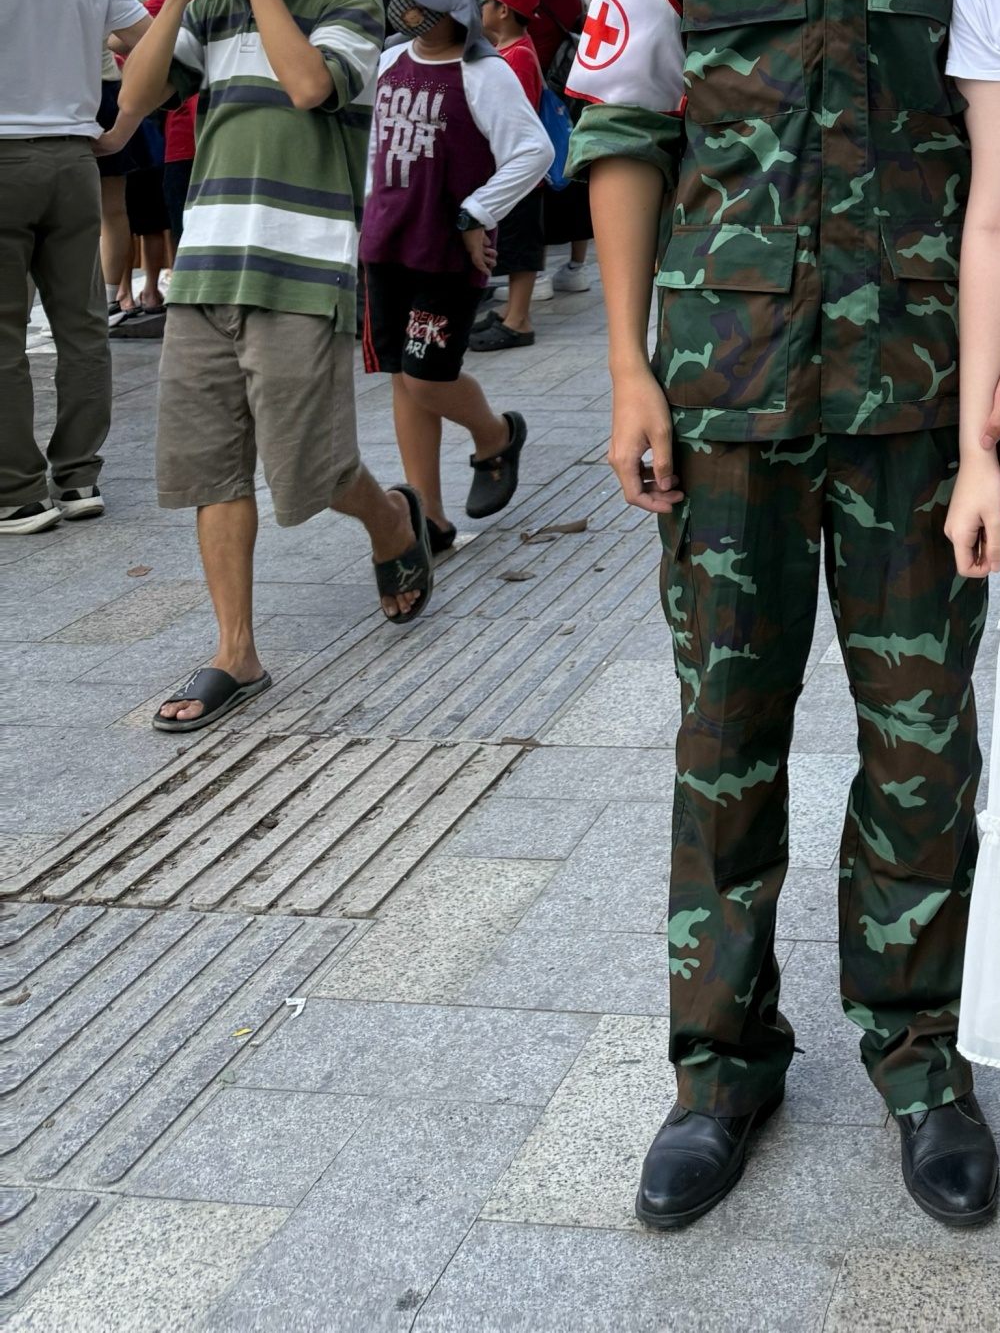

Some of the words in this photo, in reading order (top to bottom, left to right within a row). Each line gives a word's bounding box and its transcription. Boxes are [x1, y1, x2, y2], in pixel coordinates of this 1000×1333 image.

[376, 84, 448, 132] GOAL
[378, 115, 436, 158] FOR
[385, 149, 418, 188] IT
